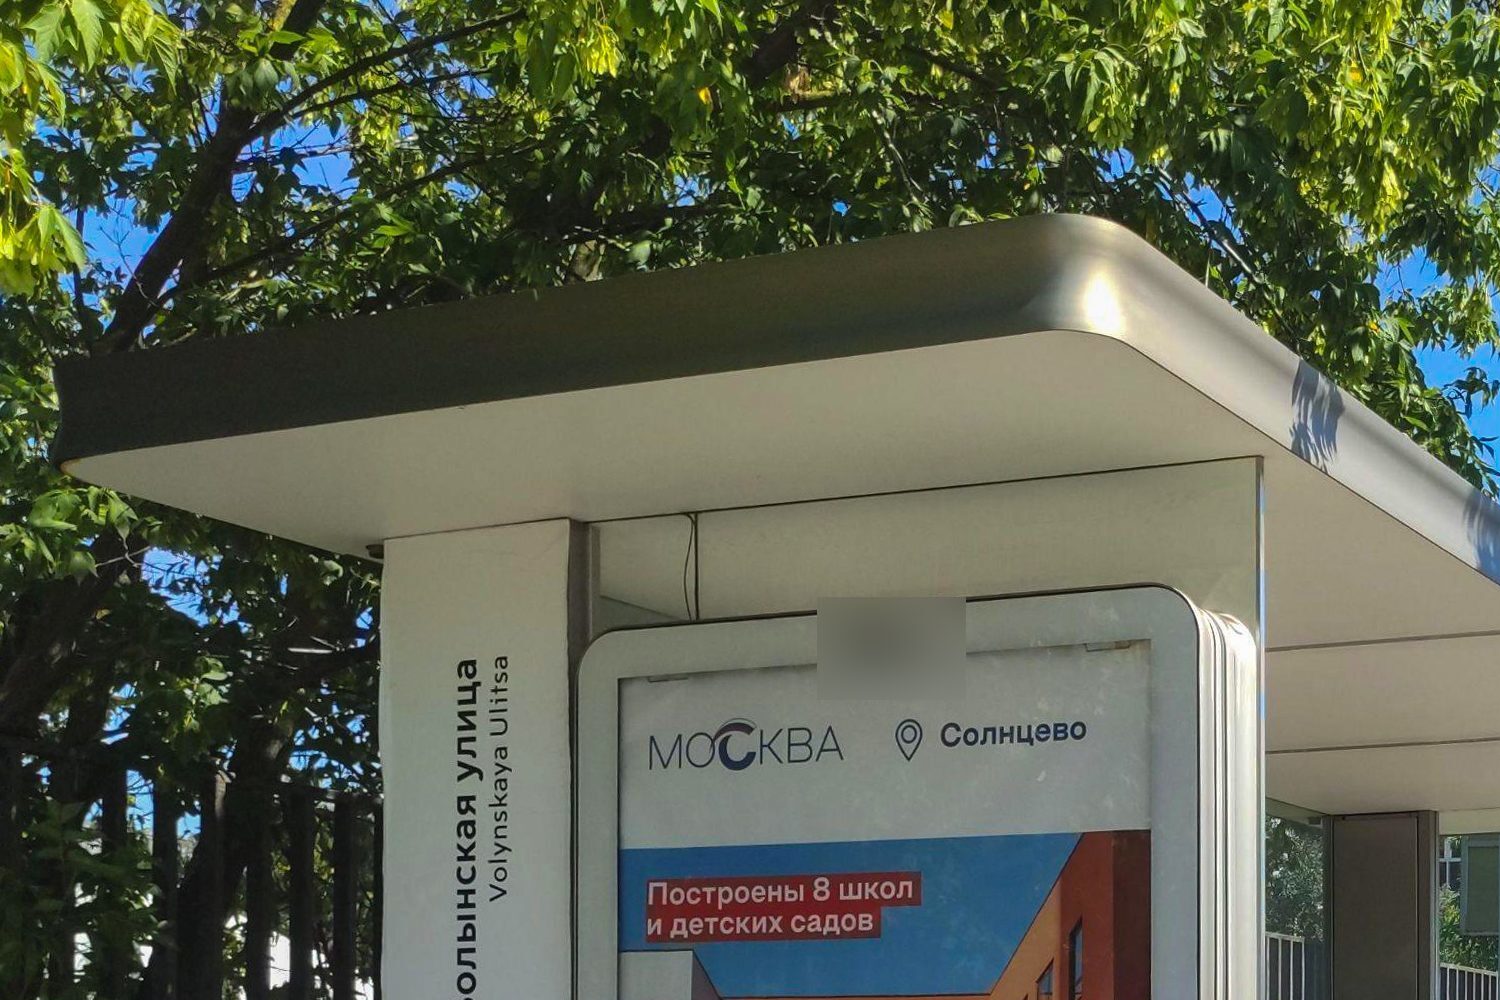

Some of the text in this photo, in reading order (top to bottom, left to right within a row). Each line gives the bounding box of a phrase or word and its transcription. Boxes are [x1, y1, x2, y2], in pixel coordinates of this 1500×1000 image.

[456, 659, 484, 783] улица
[940, 721, 1087, 748] Солнцево
[649, 718, 844, 771] МОСКВА
[488, 656, 513, 902] Volynskaya Ulitsa
[648, 877, 914, 910] Построены 8 школ
[647, 912, 874, 939] и детских садов
